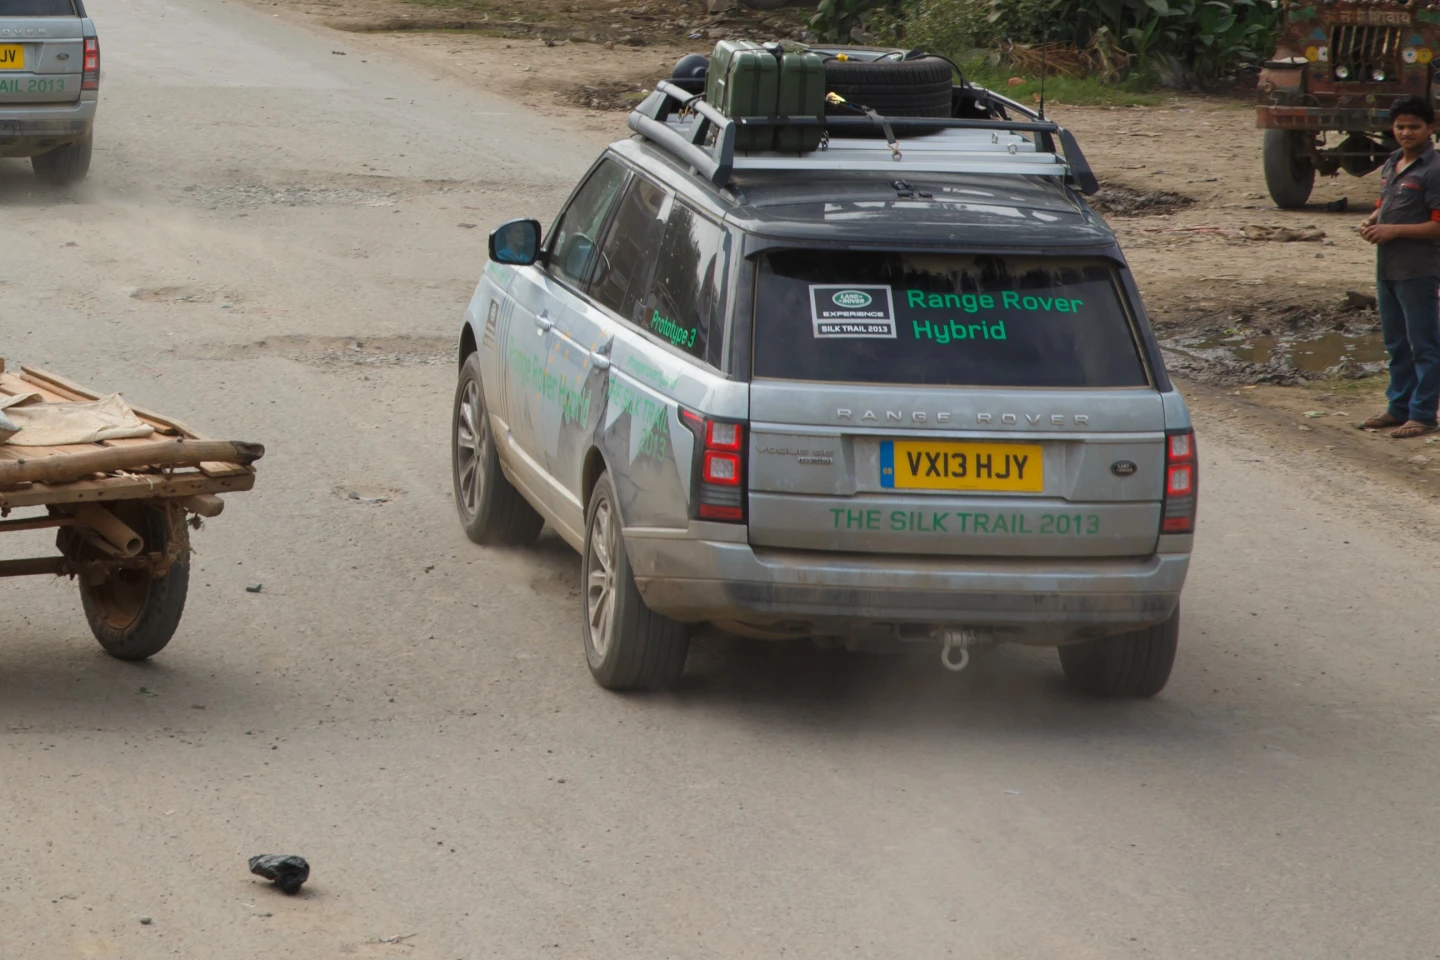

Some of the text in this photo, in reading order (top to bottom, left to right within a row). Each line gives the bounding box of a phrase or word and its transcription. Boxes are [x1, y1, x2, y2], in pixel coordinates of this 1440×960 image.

[28, 79, 65, 93] 2013
[906, 289, 1084, 314] Range Rover
[650, 309, 696, 347] Prototype 3
[912, 319, 1007, 344] Hybrid
[643, 399, 669, 435] TRAIL
[837, 408, 1091, 426] RANGE ROVER
[639, 427, 666, 462] 2013
[907, 451, 1029, 480] VX13 HJY
[829, 508, 1100, 535] THE SILK TRAIL 2013
